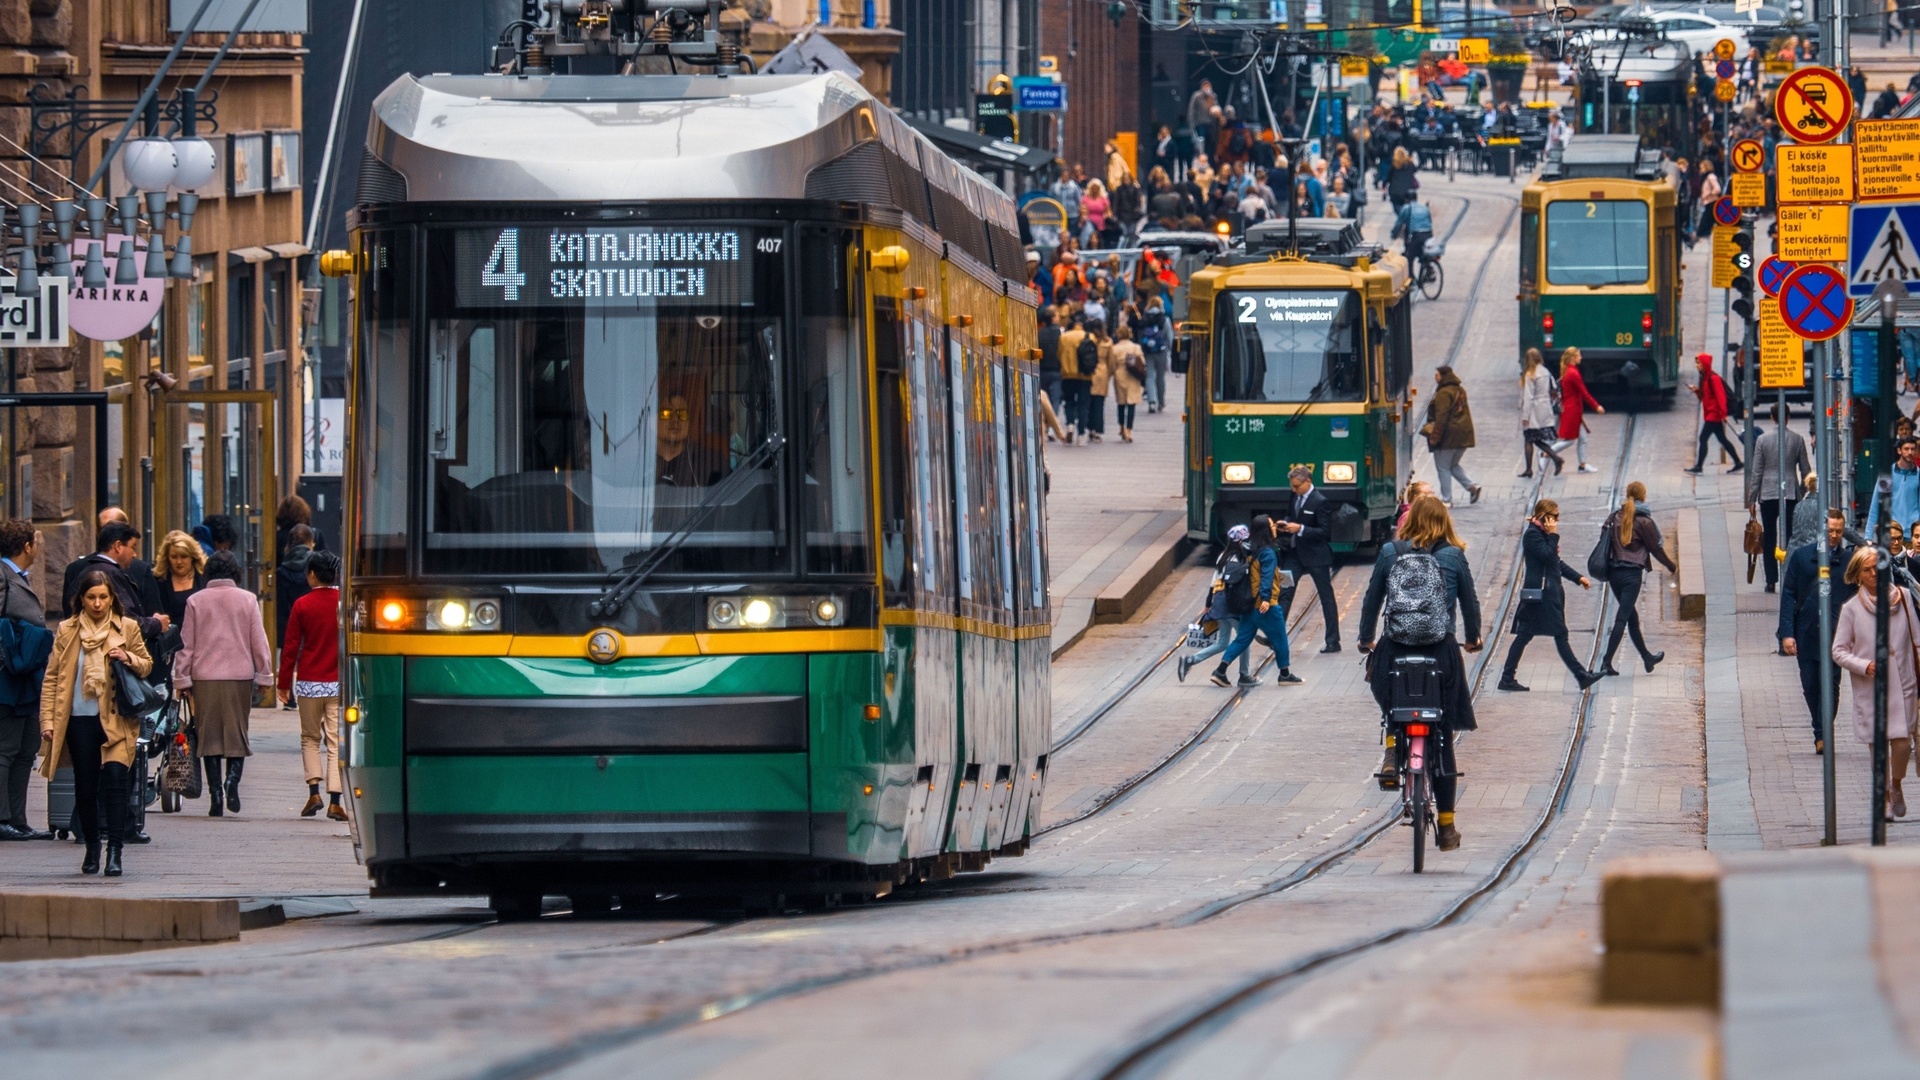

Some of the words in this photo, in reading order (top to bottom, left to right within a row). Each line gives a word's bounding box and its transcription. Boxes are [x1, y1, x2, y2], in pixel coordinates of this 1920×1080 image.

[1859, 144, 1888, 153] sallittu
[1787, 150, 1796, 160] Ei
[1800, 150, 1827, 160] koske
[1862, 164, 1902, 175] purkaville
[1863, 174, 1912, 185] ajoneuvoille
[1585, 201, 1597, 218] 2
[1780, 210, 1807, 220] Gäller
[1811, 209, 1821, 221] ej
[1781, 234, 1848, 244] -servicekörnin
[550, 232, 739, 262] KATAJANOKKA
[757, 238, 782, 253] 407
[482, 228, 526, 300] 4
[550, 267, 705, 297] SKATUDDEN
[1238, 296, 1257, 323] 2
[1269, 310, 1284, 321] via
[1615, 332, 1634, 345] 89
